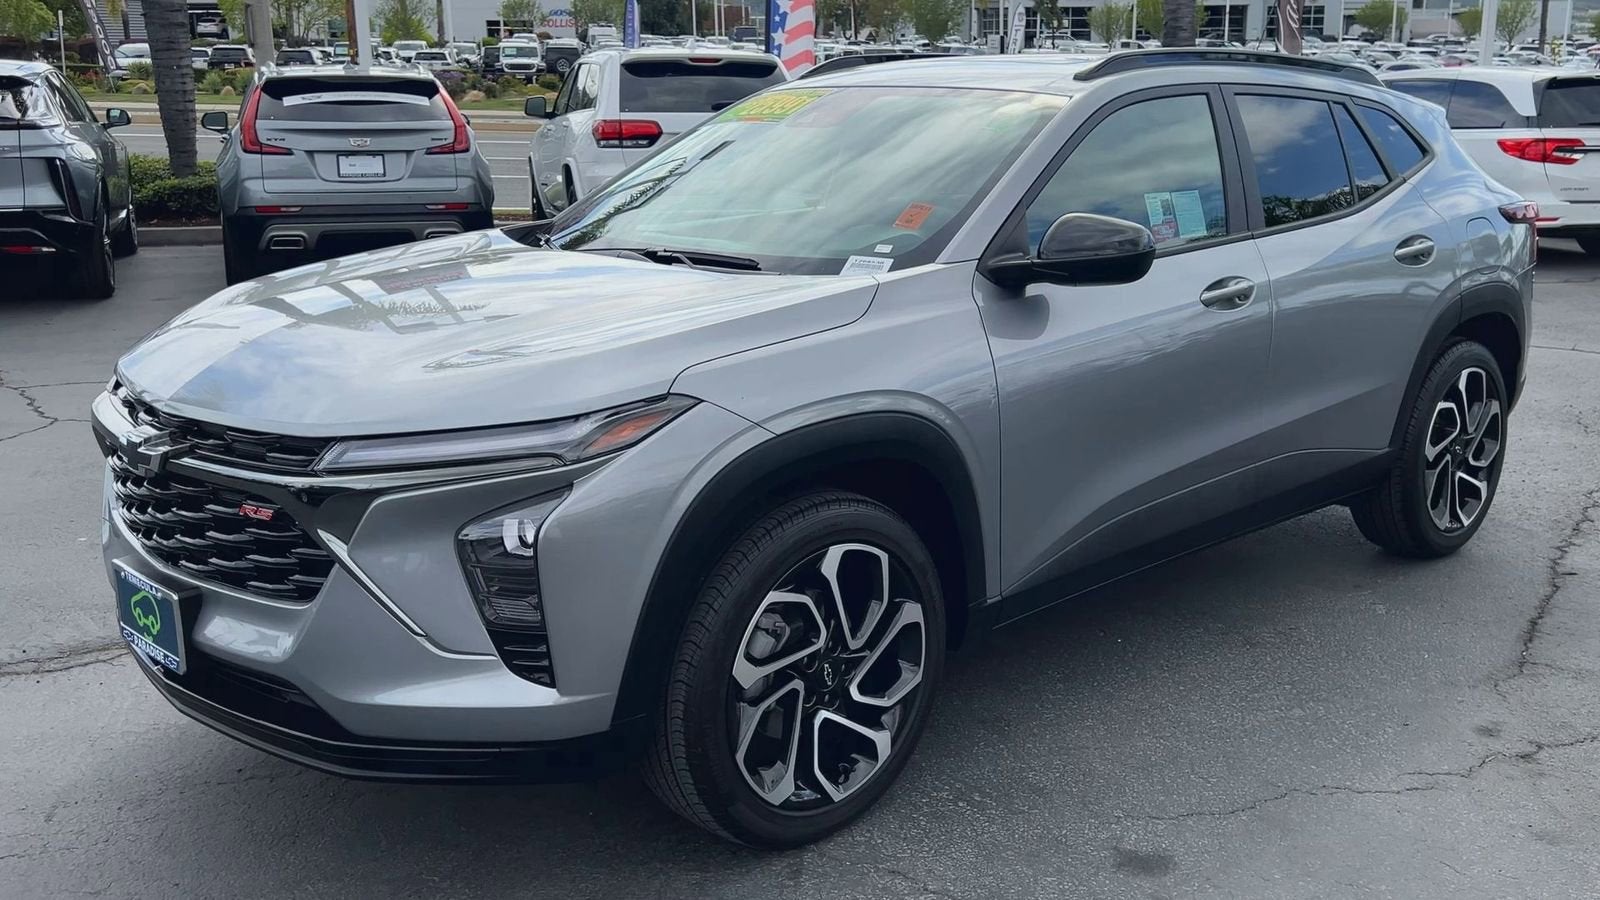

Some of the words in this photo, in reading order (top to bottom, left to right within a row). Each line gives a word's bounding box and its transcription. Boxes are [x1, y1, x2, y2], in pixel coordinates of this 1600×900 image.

[239, 503, 274, 521] RS
[125, 572, 157, 596] TEMECULA
[133, 634, 166, 664] PARADISE
